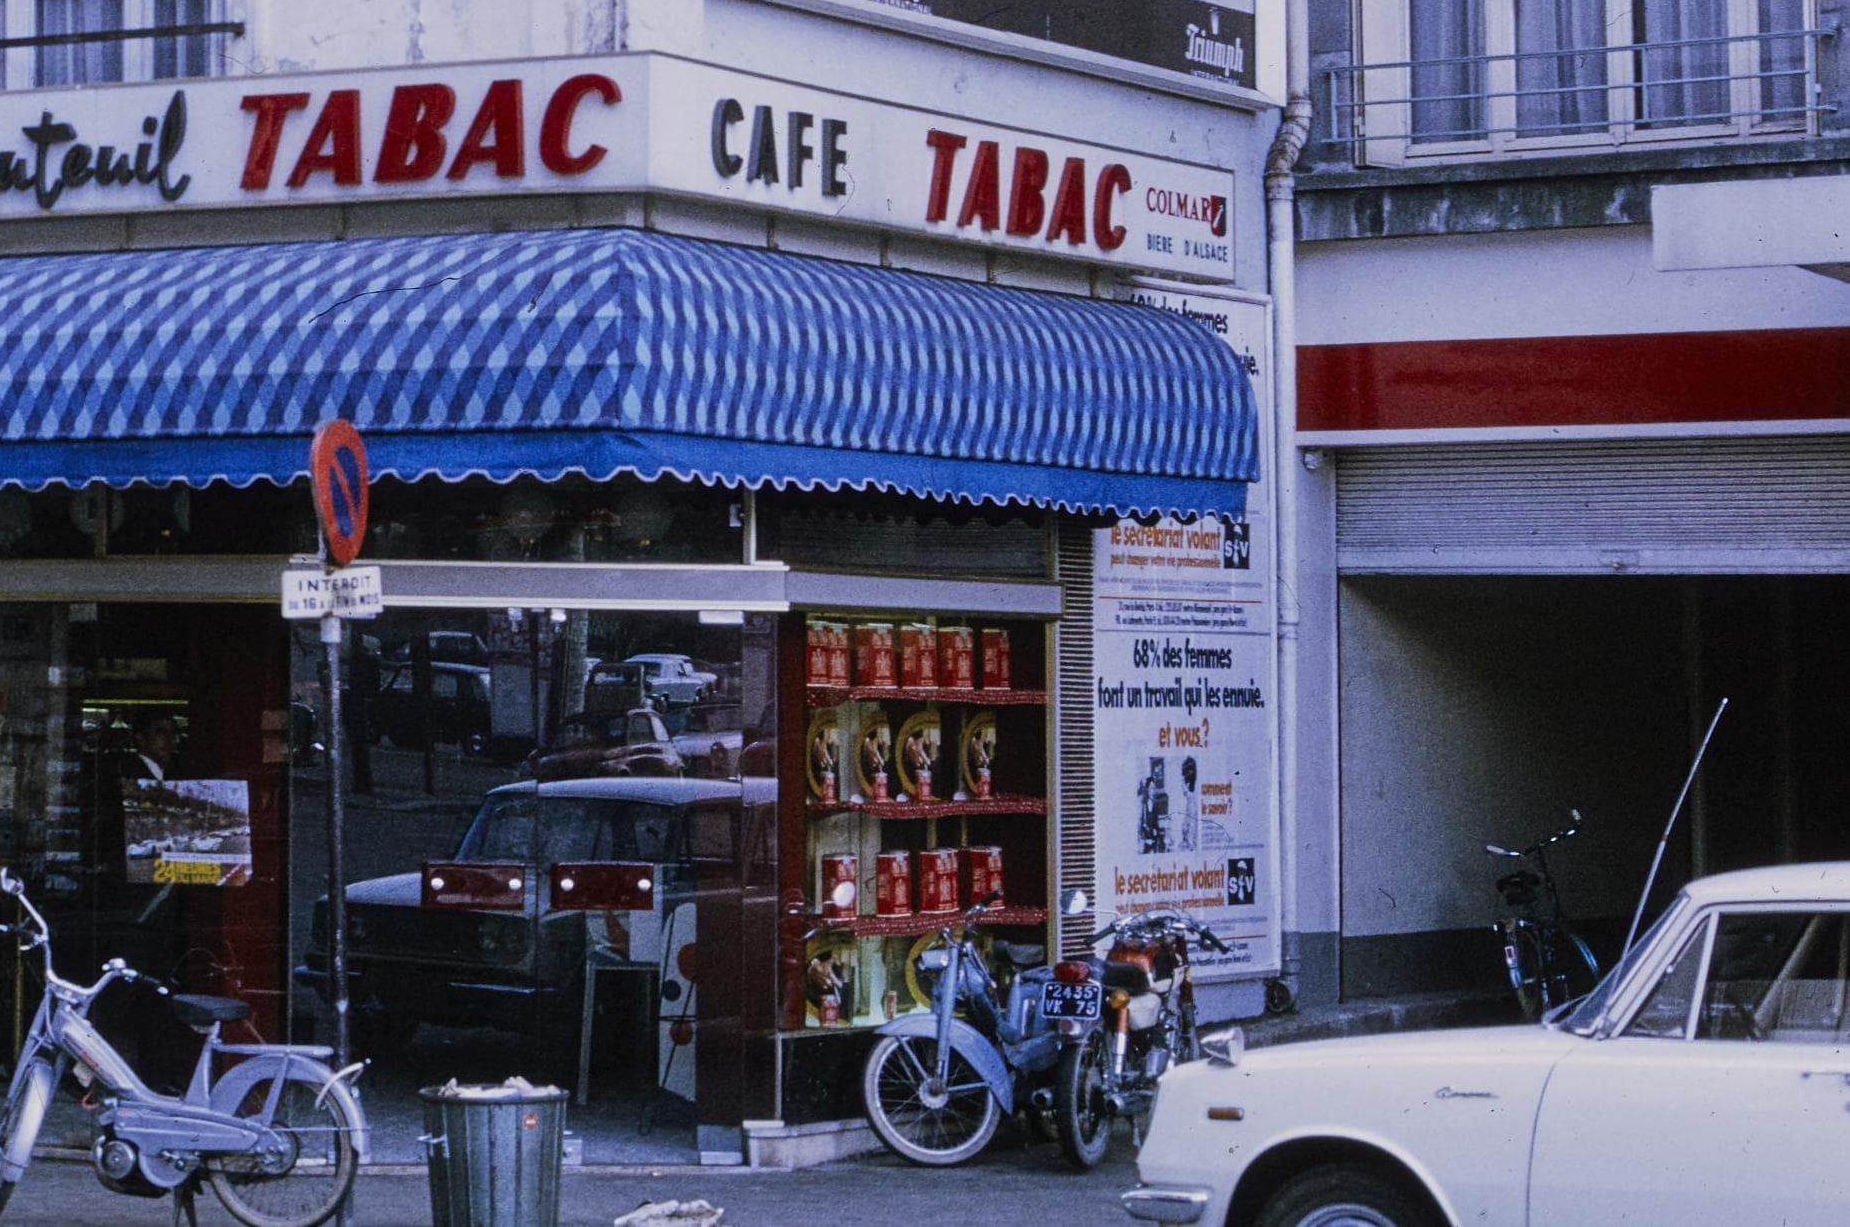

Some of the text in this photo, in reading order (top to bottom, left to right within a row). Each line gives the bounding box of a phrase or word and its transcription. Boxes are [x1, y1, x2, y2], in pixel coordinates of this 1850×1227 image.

[1185, 23, 1244, 77] Triumph
[239, 73, 623, 191] TABAC
[711, 98, 1132, 252] CAFE TABAC
[1146, 187, 1211, 224] COLMAR
[1147, 233, 1229, 263] BIERE D'ALSACE
[1187, 523, 1221, 551] volant
[298, 576, 371, 592] INTERDIT
[303, 597, 316, 609] 16
[1163, 637, 1182, 668] des
[1184, 637, 1232, 669] femmes
[1098, 677, 1265, 716] font un travail qui les ennuie.
[1158, 722, 1171, 748] et
[1114, 866, 1125, 896] le
[1191, 860, 1225, 890] volant
[1053, 984, 1093, 999] 2435
[1076, 1001, 1096, 1015] 75
